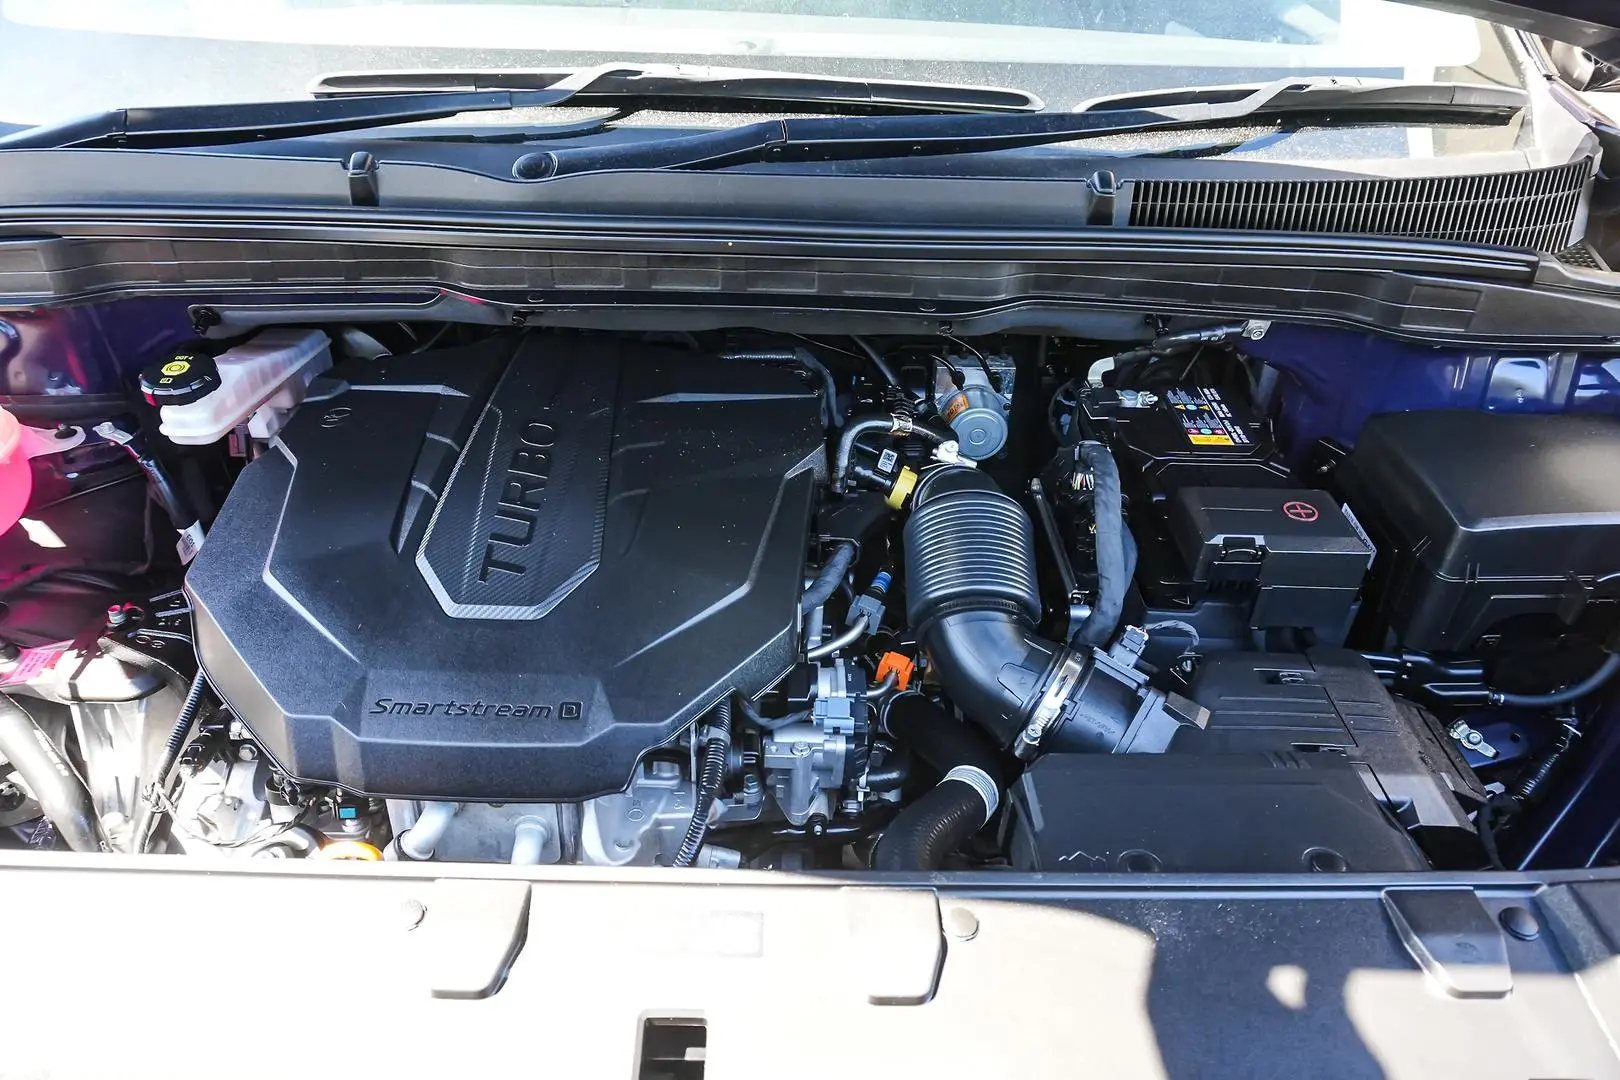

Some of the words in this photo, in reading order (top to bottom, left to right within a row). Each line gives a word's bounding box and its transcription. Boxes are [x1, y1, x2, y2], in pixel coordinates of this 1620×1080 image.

[478, 421, 556, 585] TURBO
[368, 698, 553, 719] Smartstream
[560, 703, 580, 719] D
